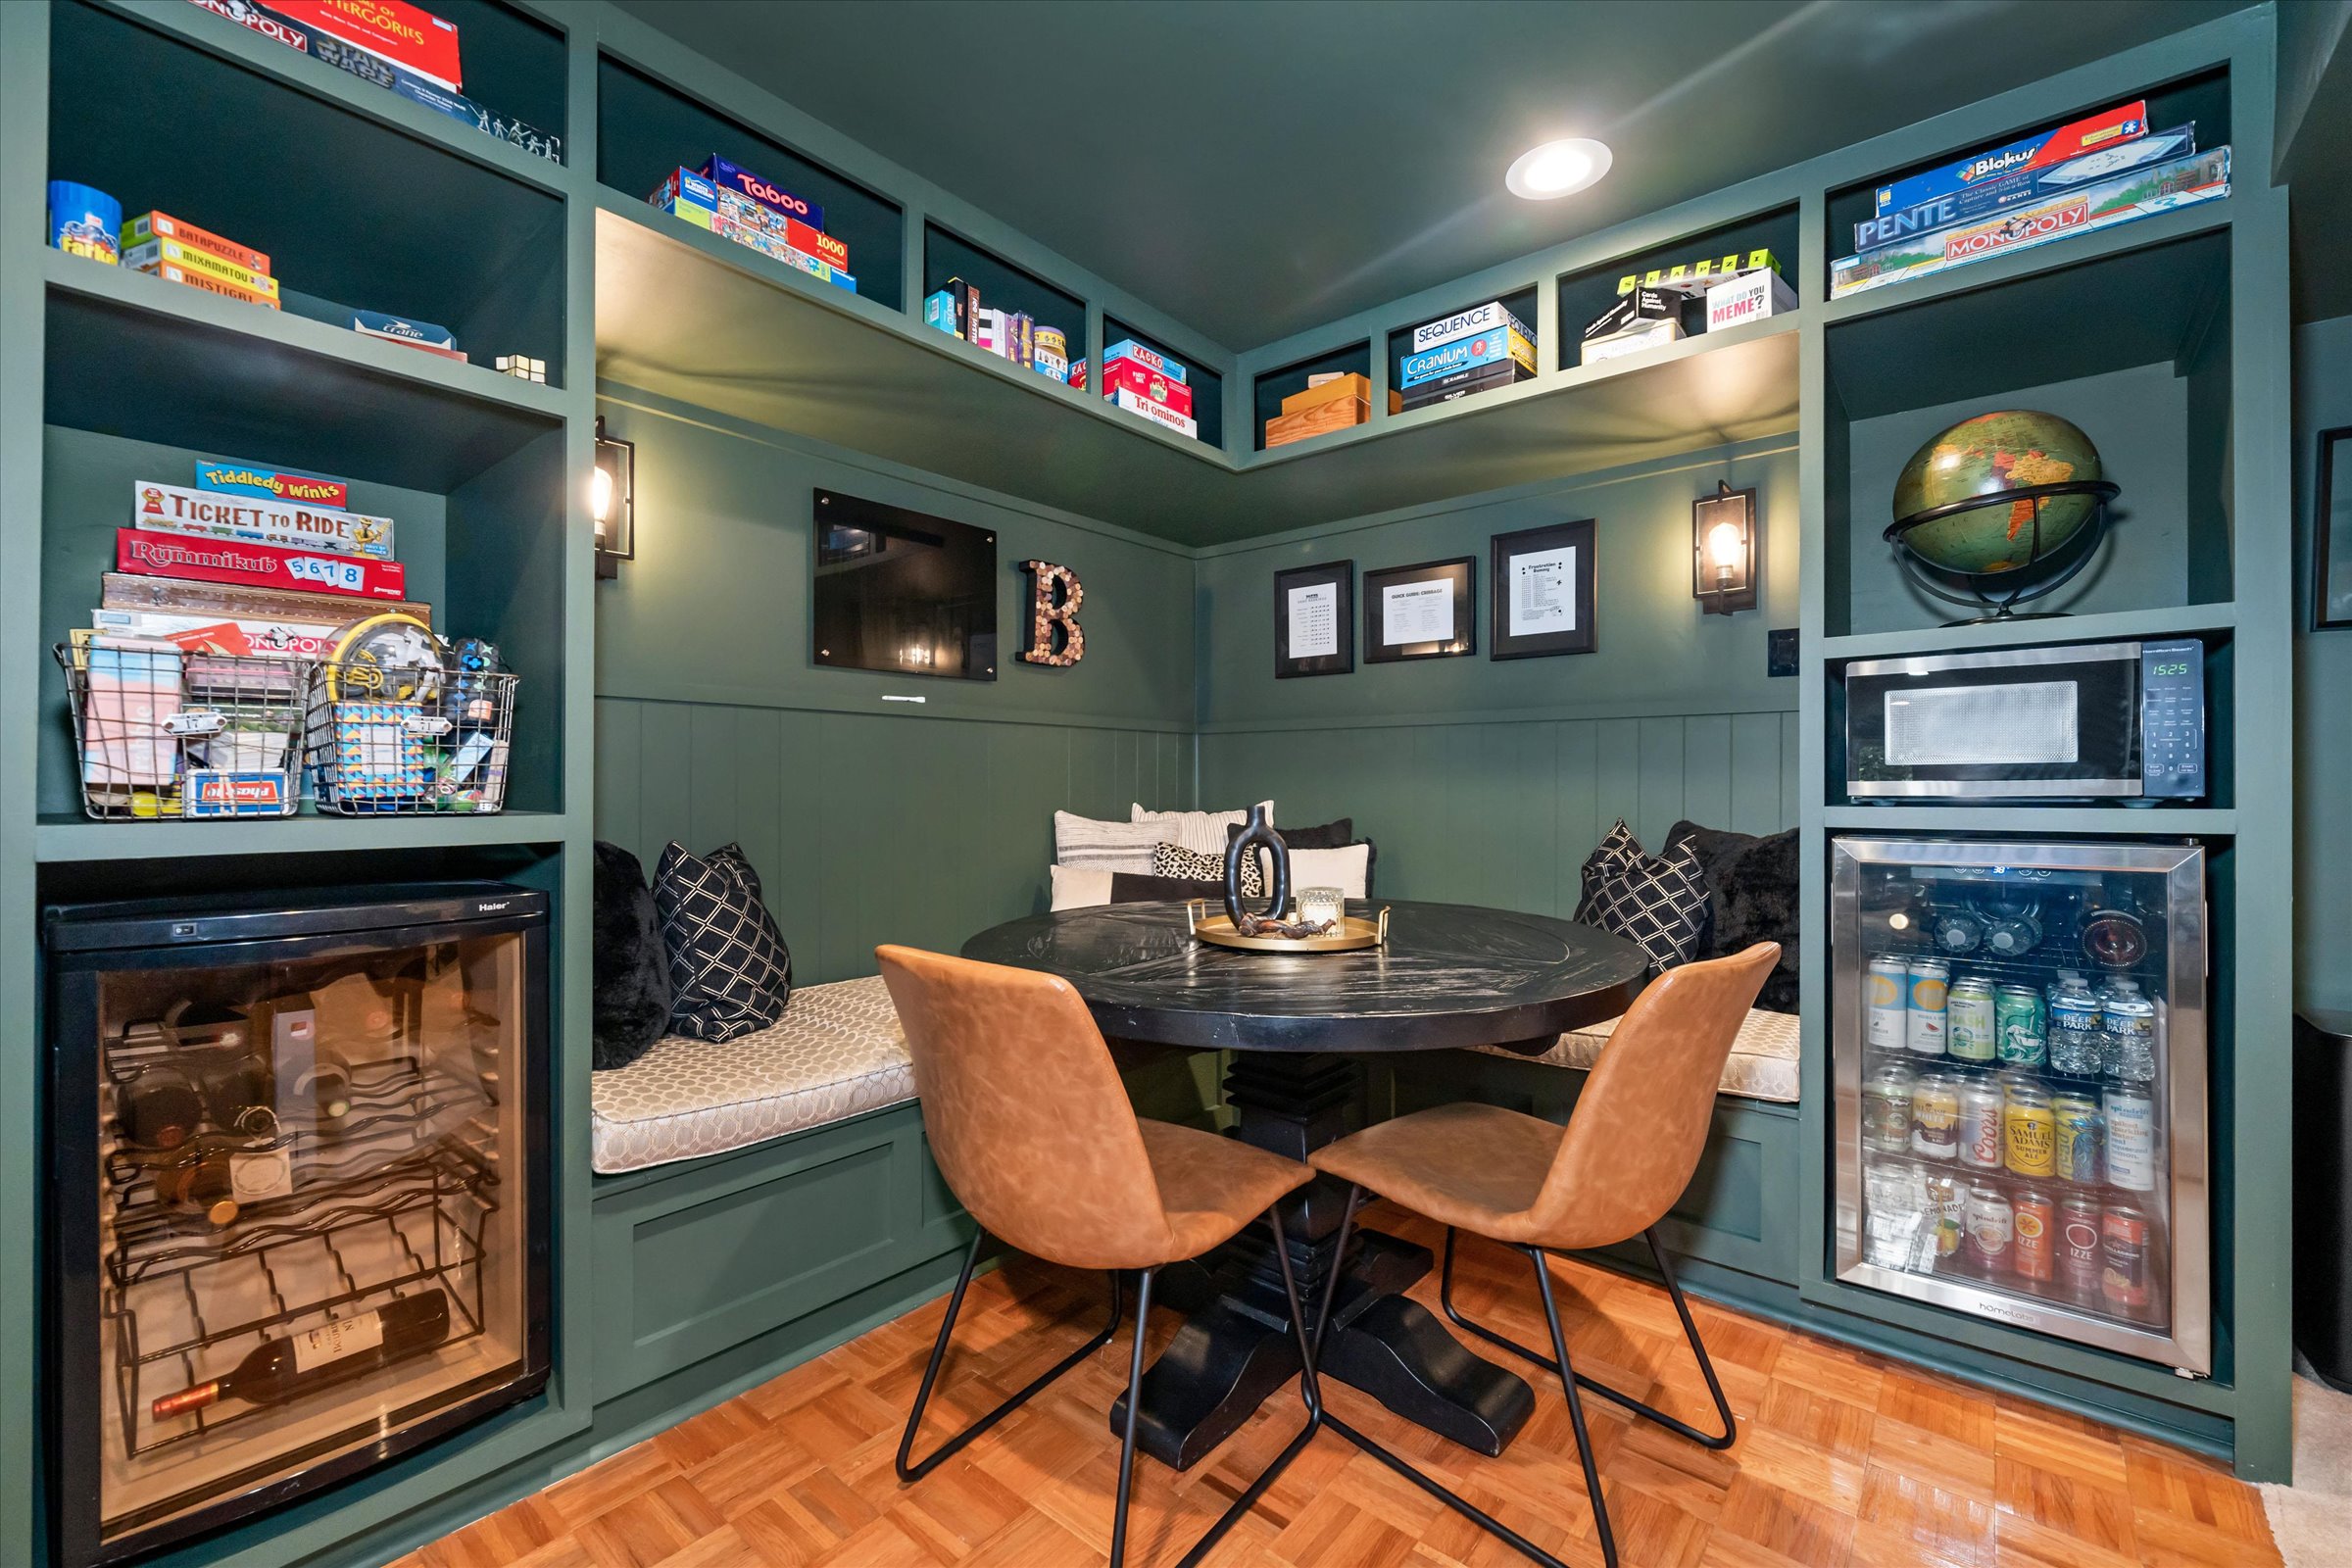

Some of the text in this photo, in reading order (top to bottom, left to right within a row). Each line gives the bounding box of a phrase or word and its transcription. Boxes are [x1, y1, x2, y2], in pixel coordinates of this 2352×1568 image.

[323, 0, 424, 45] TERGORIES
[1975, 147, 2036, 177] Blokus
[1998, 176, 2021, 187] GAME
[737, 173, 808, 216] Taboo
[1859, 196, 1958, 247] PENTE
[815, 233, 845, 257] 1000
[182, 250, 249, 283] MIXAMATOU
[185, 272, 254, 303] MISTIGRI
[1748, 284, 1765, 297] YOU
[1711, 294, 1765, 324] MEME?
[382, 323, 423, 339] crane
[1418, 307, 1491, 343] SEQUENCE
[205, 469, 340, 499] Tiddledy Winks
[169, 493, 350, 540] TICKET TO RIDE
[131, 540, 278, 573] Rummikub
[292, 561, 304, 573] 5
[310, 563, 320, 574] 6
[323, 564, 334, 578] 7
[345, 567, 358, 583] 8
[1016, 559, 1086, 667] B
[2153, 663, 2187, 676] 1525
[478, 903, 507, 911] Haier
[2063, 1020, 2092, 1031] PARK
[2064, 1012, 2092, 1024] DEER
[2107, 1017, 2134, 1027] DEER
[2107, 1024, 2135, 1036] PARK
[2110, 1104, 2149, 1116] spindrift
[1972, 1107, 1998, 1163] Coors
[2010, 1125, 2053, 1141] SAMUEL
[2013, 1135, 2051, 1150] ADAMS
[2016, 1145, 2048, 1154] SUMMER
[1972, 1212, 2008, 1225] spindrift
[2018, 1235, 2038, 1249] IZZE
[2070, 1248, 2093, 1261] IZZE
